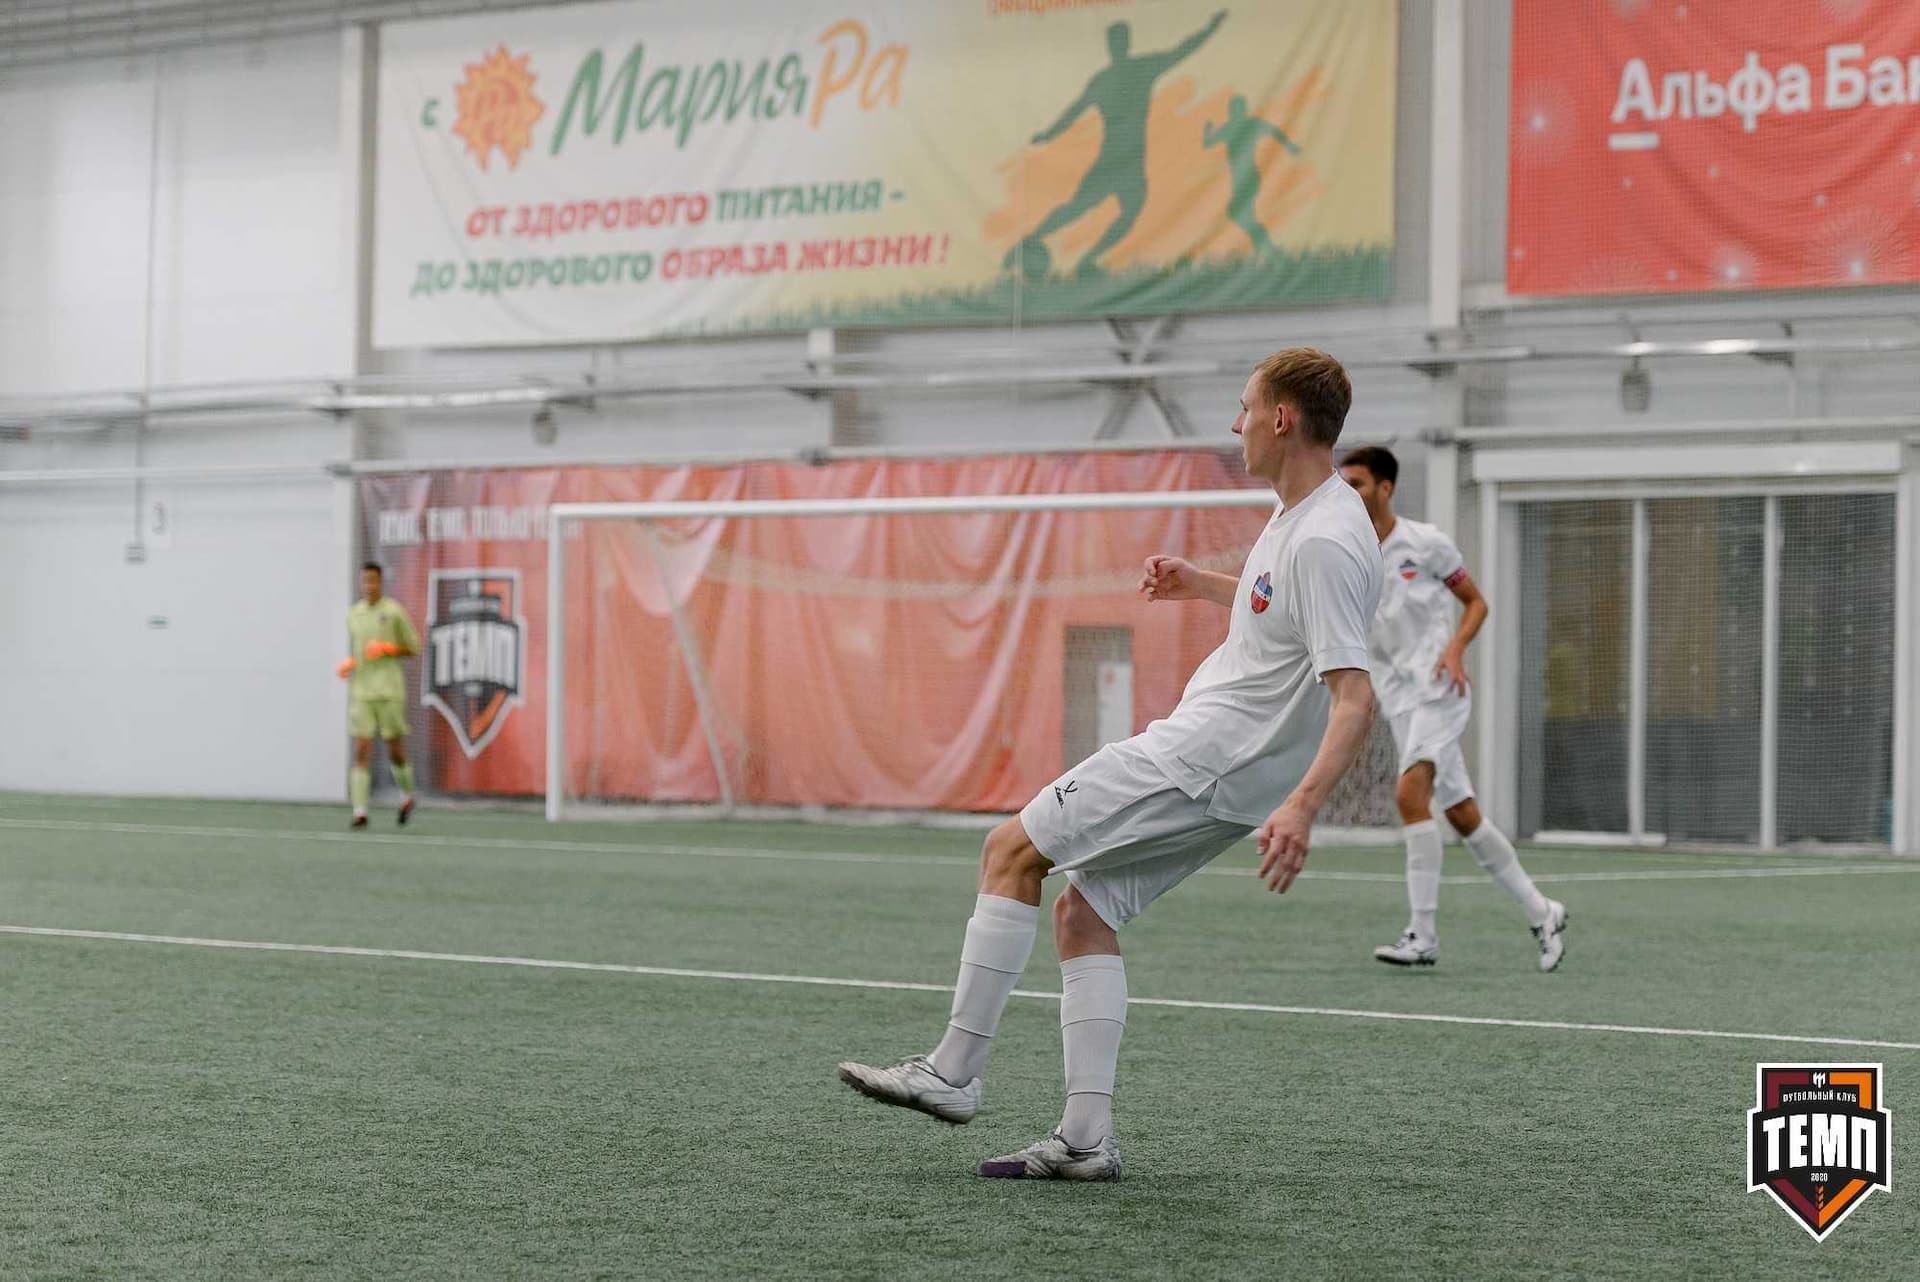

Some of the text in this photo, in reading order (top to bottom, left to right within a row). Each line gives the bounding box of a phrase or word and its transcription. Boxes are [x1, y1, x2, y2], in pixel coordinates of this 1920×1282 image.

[1610, 51, 1812, 133] Альфа
[465, 205, 508, 238] ОТ
[511, 191, 709, 240] ЗДОРОВОГО
[715, 178, 884, 222] ПИТАНИЯ
[410, 259, 457, 298] ДО
[463, 251, 653, 294] ЗДОРОВОГО
[660, 240, 789, 281] ОБРАЗА
[431, 620, 518, 689] ТЕМП
